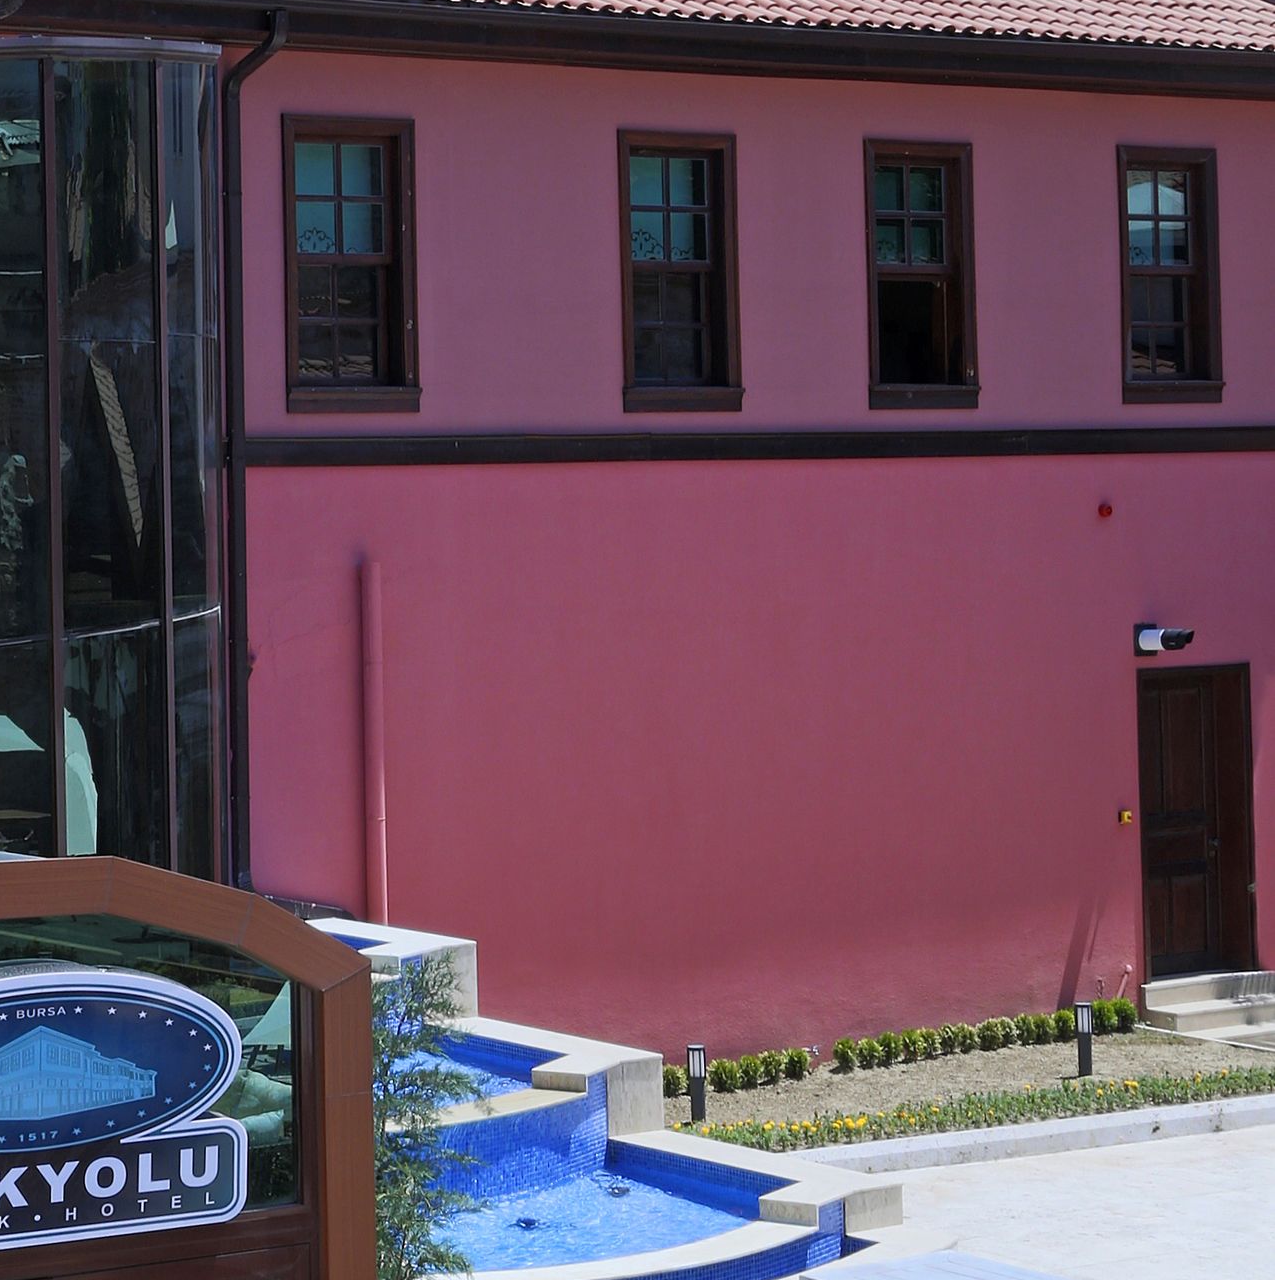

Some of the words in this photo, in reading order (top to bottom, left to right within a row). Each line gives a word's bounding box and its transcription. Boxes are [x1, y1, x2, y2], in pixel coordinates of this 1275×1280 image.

[16, 1006, 67, 1019] BURSA
[18, 1130, 59, 1142] 1517
[65, 1191, 215, 1221] HOTEL
